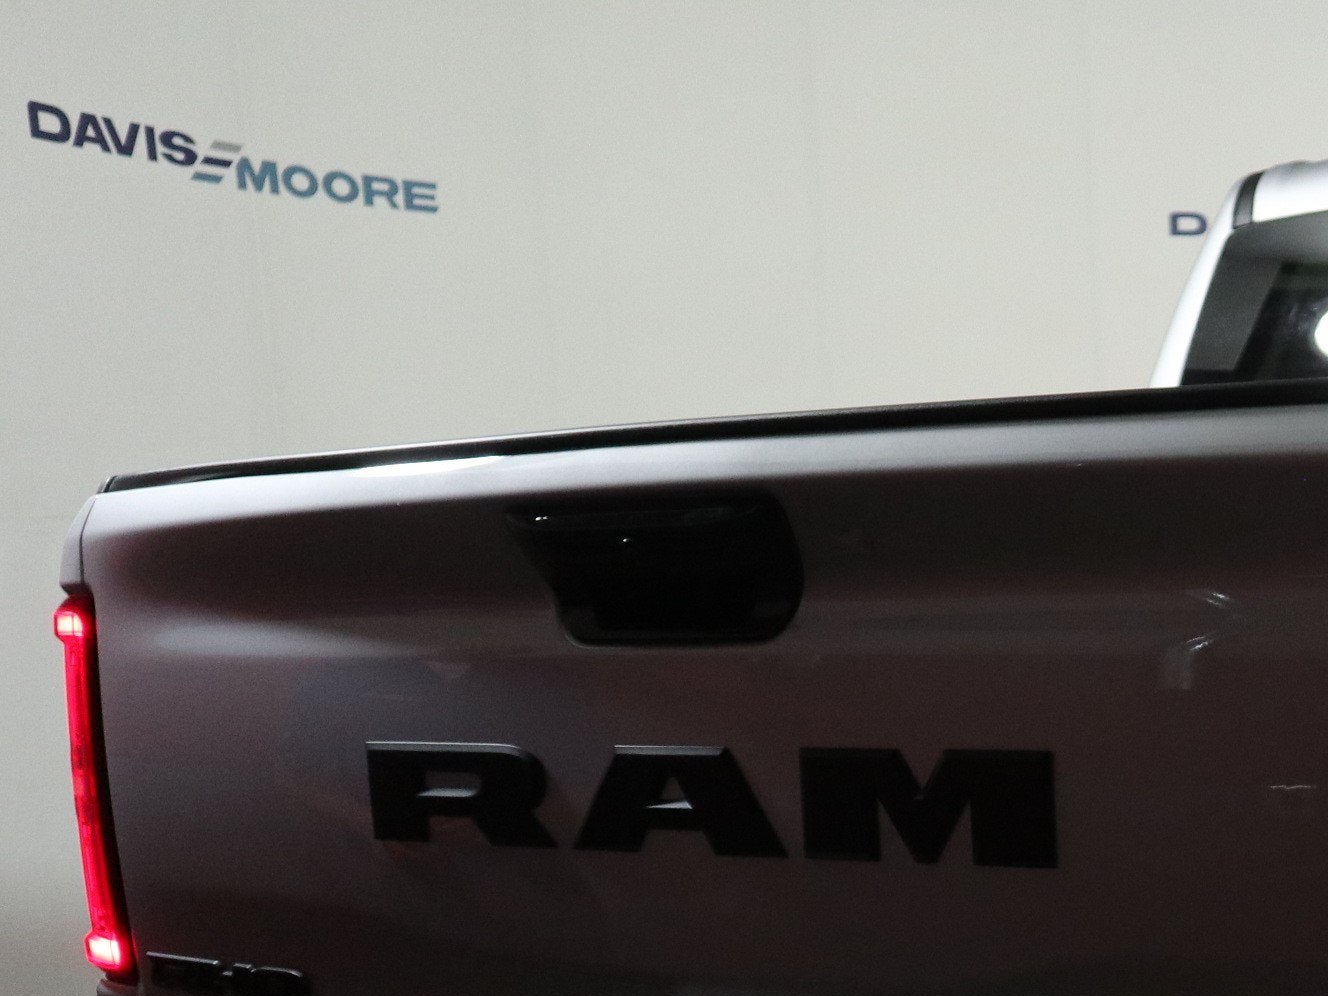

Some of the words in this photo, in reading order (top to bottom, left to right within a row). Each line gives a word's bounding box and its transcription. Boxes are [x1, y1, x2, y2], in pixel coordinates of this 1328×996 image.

[27, 99, 199, 167] DAVIS
[235, 156, 440, 214] MOORE
[365, 740, 1059, 869] RAM
